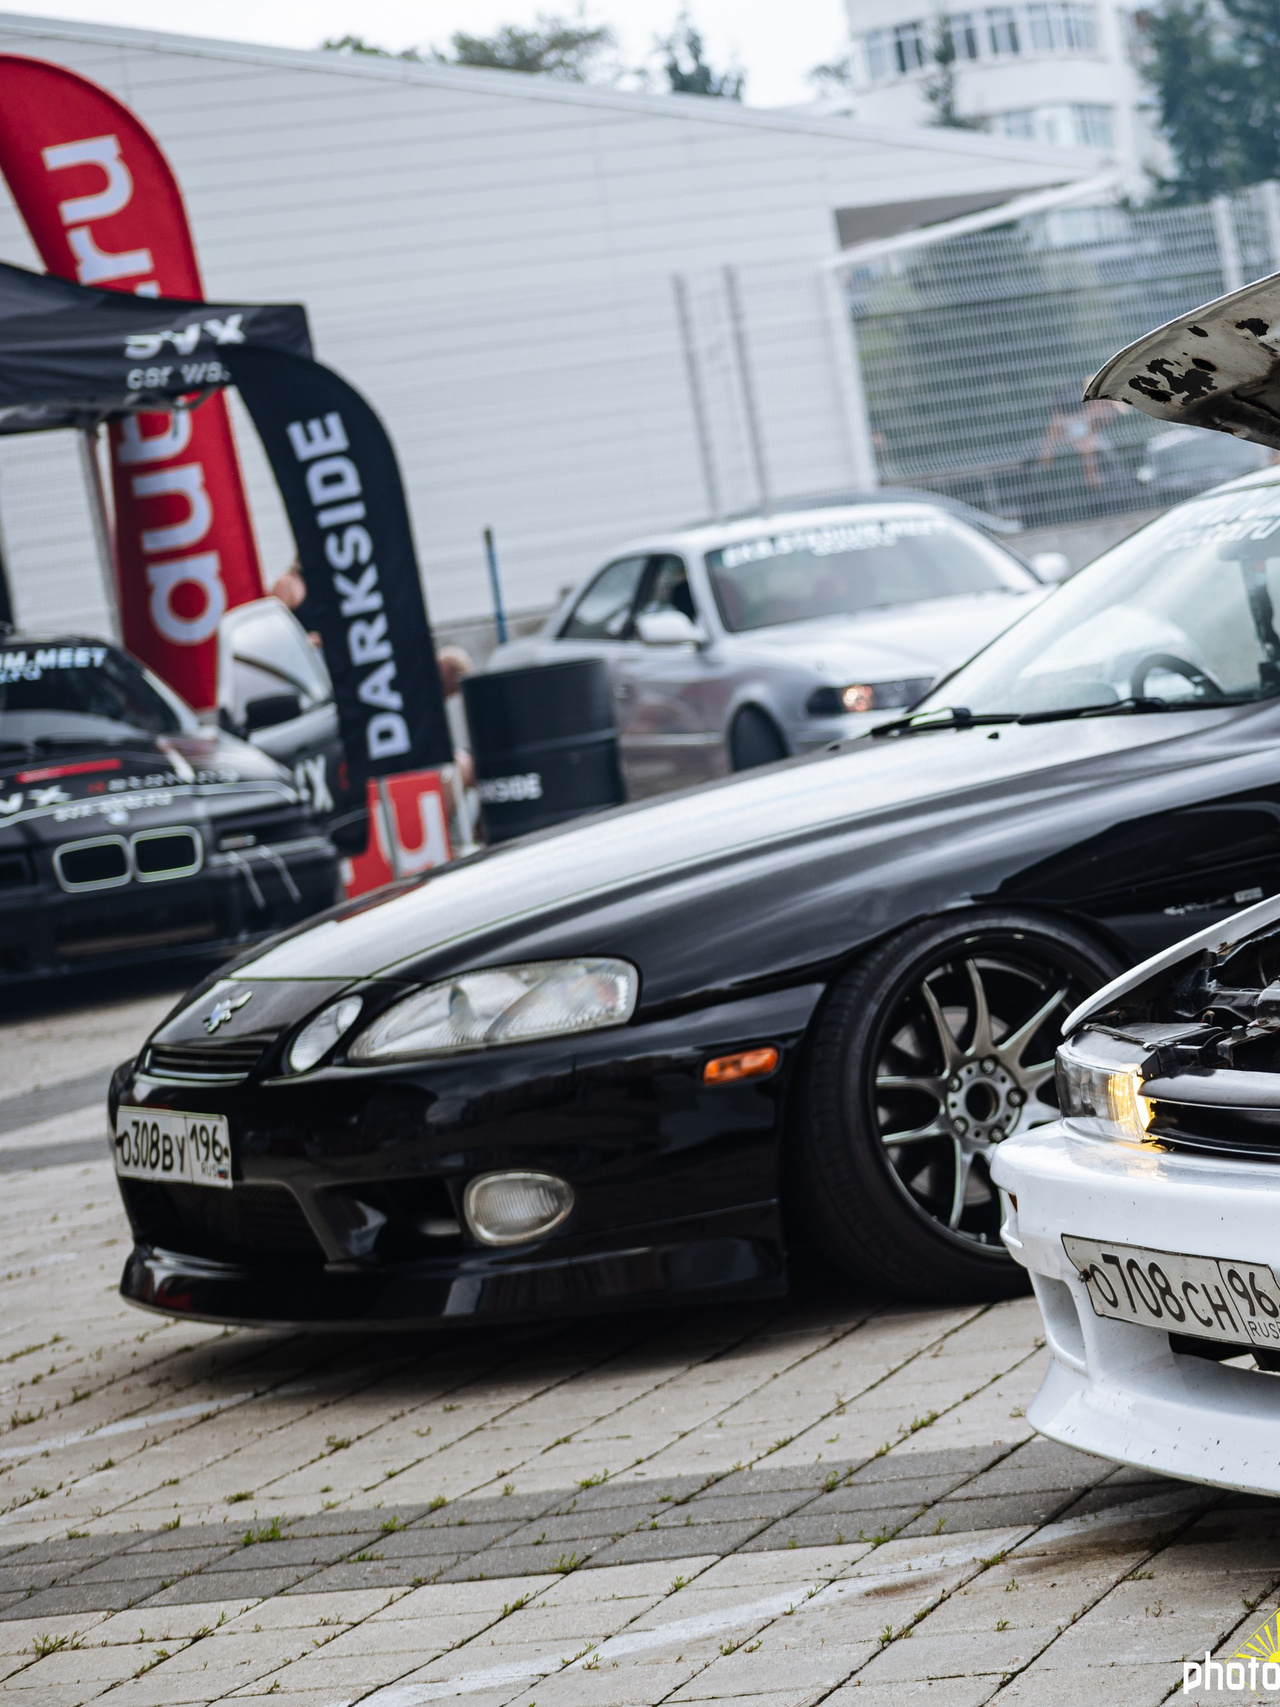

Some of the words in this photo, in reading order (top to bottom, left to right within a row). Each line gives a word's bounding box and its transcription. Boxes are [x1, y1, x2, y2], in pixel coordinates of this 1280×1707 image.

[286, 411, 412, 760] DARKSIDE
[190, 1123, 223, 1163] 196
[201, 1162, 218, 1178] RUS
[1227, 1269, 1279, 1318] 96
[1250, 1320, 1280, 1340] RUS
